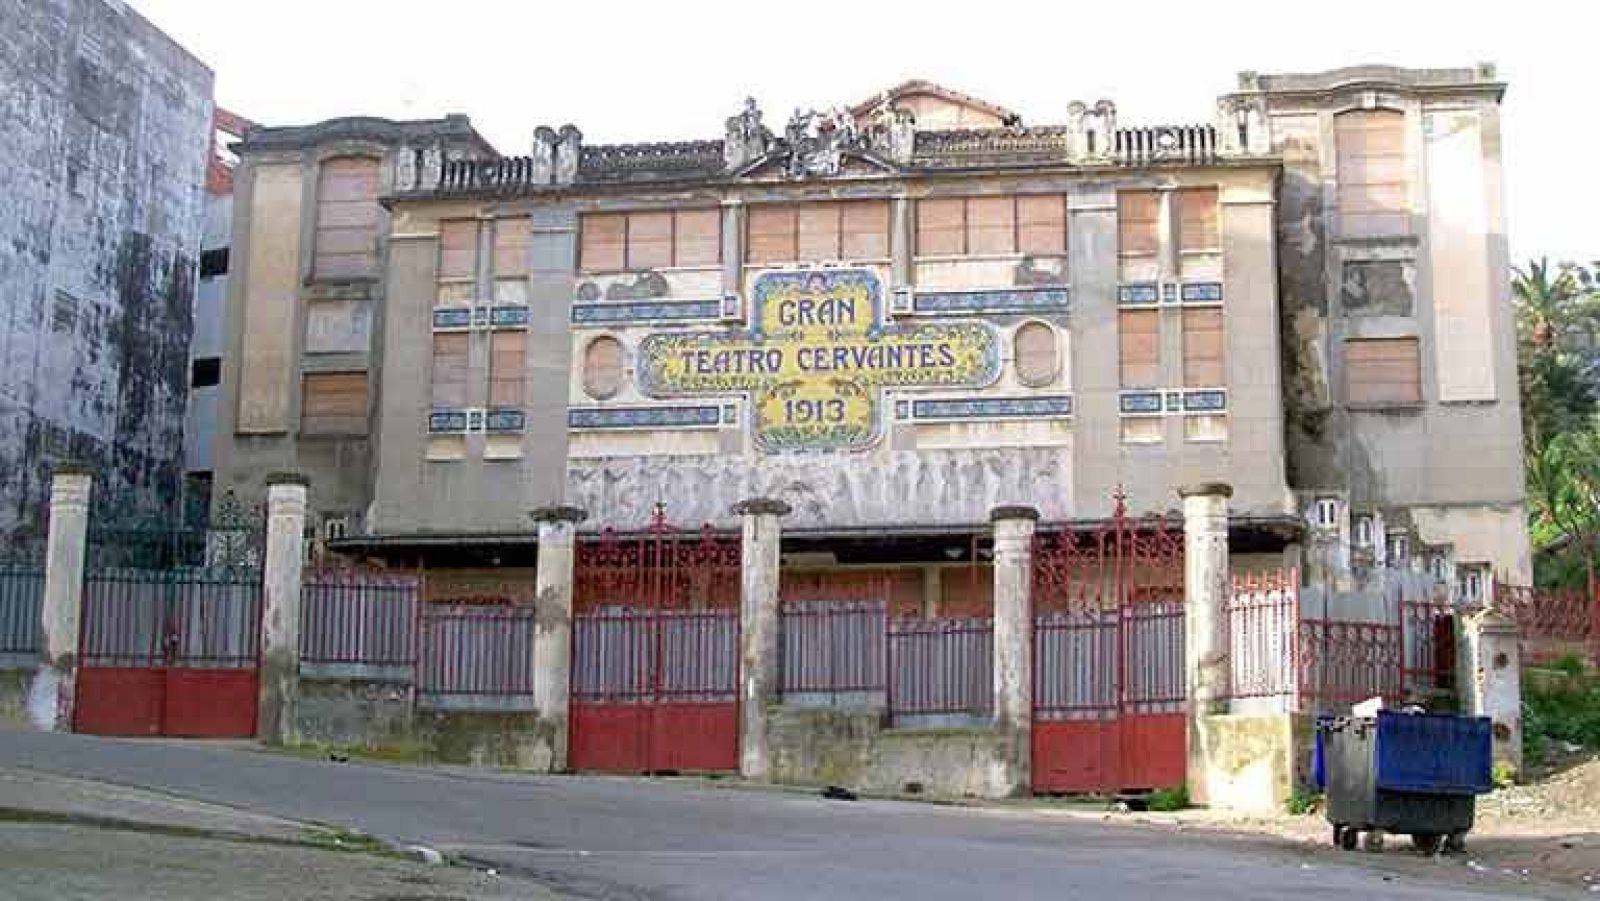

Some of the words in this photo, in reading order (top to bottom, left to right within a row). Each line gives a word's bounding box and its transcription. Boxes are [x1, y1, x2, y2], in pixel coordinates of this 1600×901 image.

[778, 298, 855, 326] GRAN
[681, 347, 782, 374] TEATRO
[797, 343, 955, 371] CERVANTES
[784, 399, 845, 423] 1913
